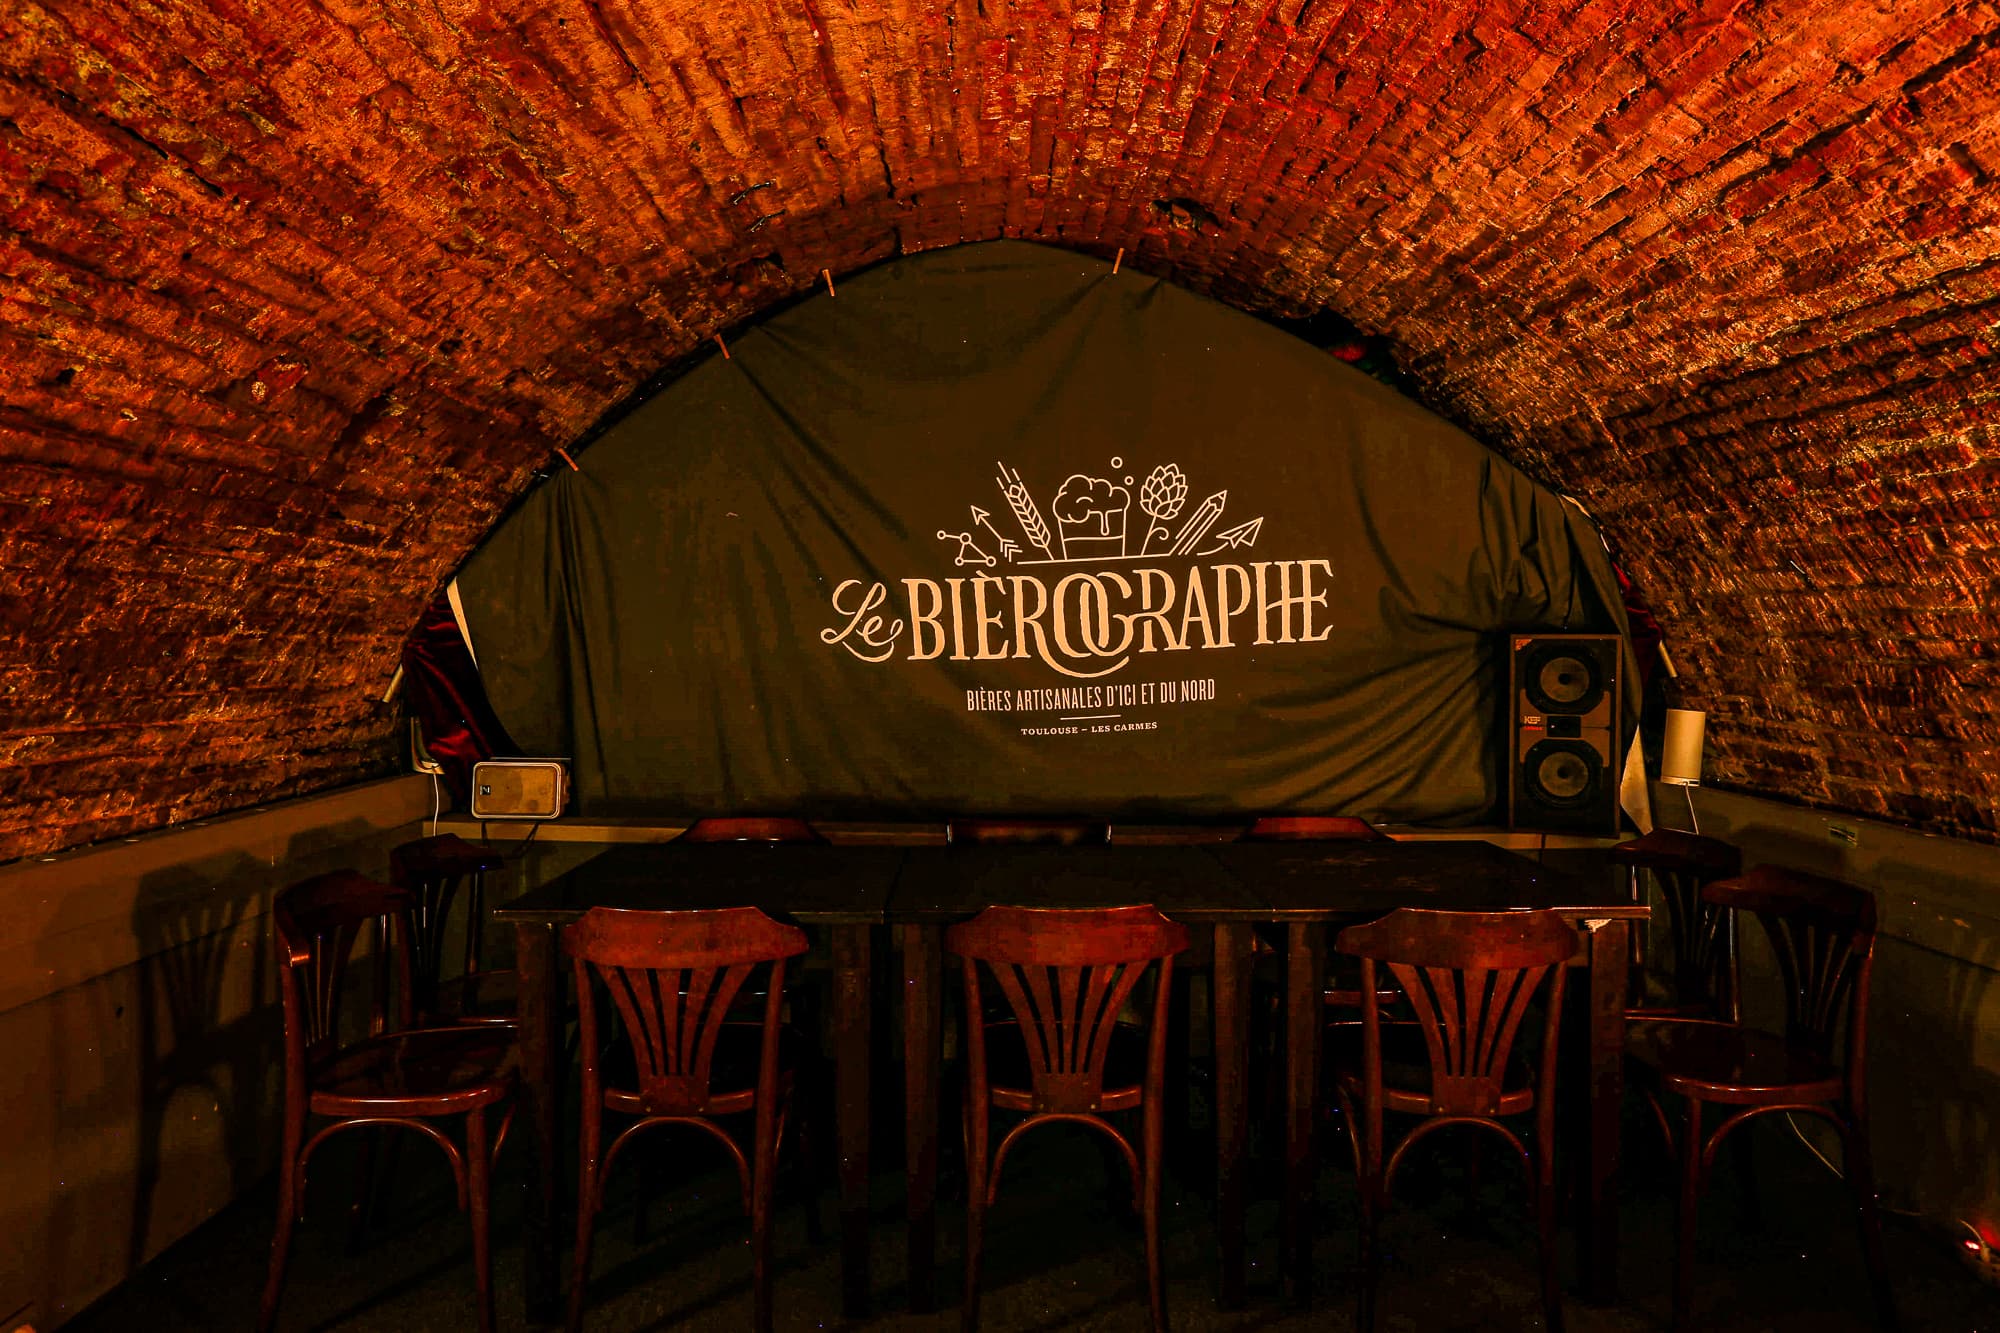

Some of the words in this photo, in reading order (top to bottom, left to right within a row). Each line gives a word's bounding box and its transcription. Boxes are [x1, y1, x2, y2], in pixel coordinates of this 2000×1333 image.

[820, 578, 904, 663] Le
[901, 559, 1334, 678] BIÈROGRAPHE
[966, 686, 1012, 712] BIÈRES
[1016, 686, 1102, 711] ARTISANALES
[1106, 684, 1136, 707] D'ICI
[1141, 682, 1156, 705] ET
[1160, 681, 1177, 704] DU
[1181, 678, 1216, 703] NORD
[1020, 726, 1079, 736] TOULOUSE
[1091, 725, 1111, 733] LES
[1114, 721, 1159, 732] CARMES
